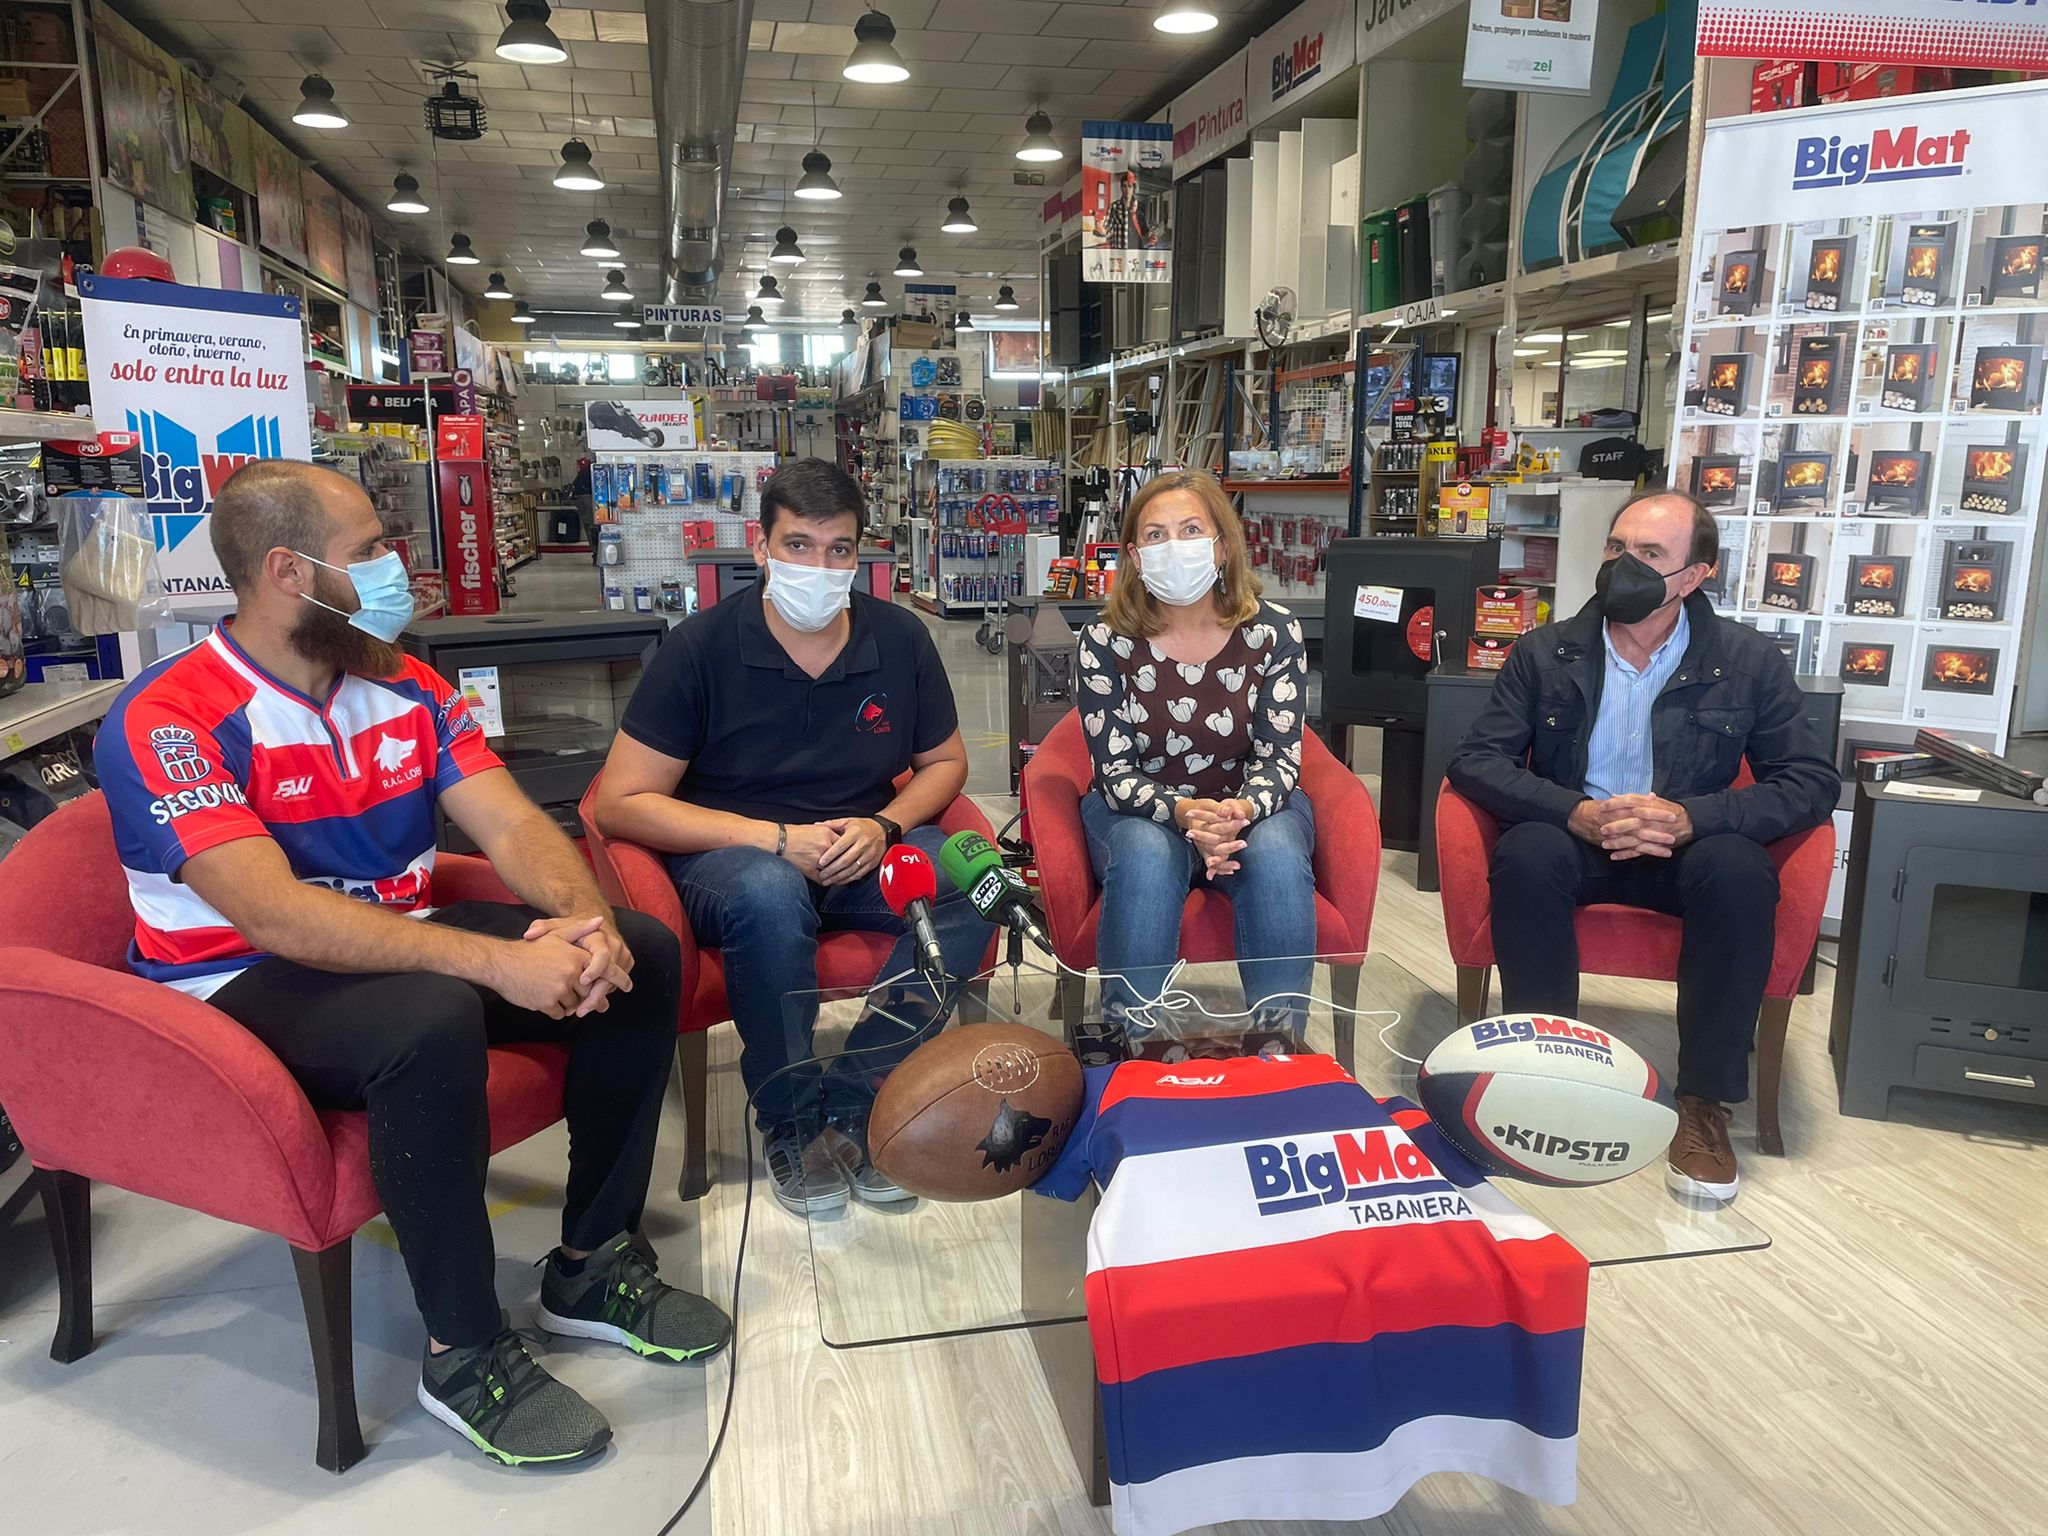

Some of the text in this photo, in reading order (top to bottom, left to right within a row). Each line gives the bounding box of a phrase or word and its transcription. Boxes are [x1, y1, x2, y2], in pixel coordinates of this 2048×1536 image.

[1494, 26, 1520, 37] protegen
[1568, 33, 1591, 41] madera
[1272, 32, 1324, 93] BigMat
[1198, 98, 1243, 146] Pintura
[1794, 126, 1971, 186] BigMat
[645, 308, 722, 322] PINTURAS
[1407, 301, 1437, 325] CAJA
[123, 324, 266, 351] En primavera, verano,
[149, 343, 246, 363] otoño, inverno,
[110, 359, 288, 390] solo entra la luz
[638, 413, 689, 423] ZUNDER
[1592, 451, 1625, 463] STAFF
[458, 511, 482, 590] fischer
[975, 877, 996, 901] ONDA
[982, 884, 1000, 906] CERO
[1471, 1017, 1611, 1048] BigMat
[1535, 1043, 1614, 1067] TABANERA
[1244, 1130, 1435, 1204] BigMa
[1348, 1196, 1473, 1225] TABANERA
